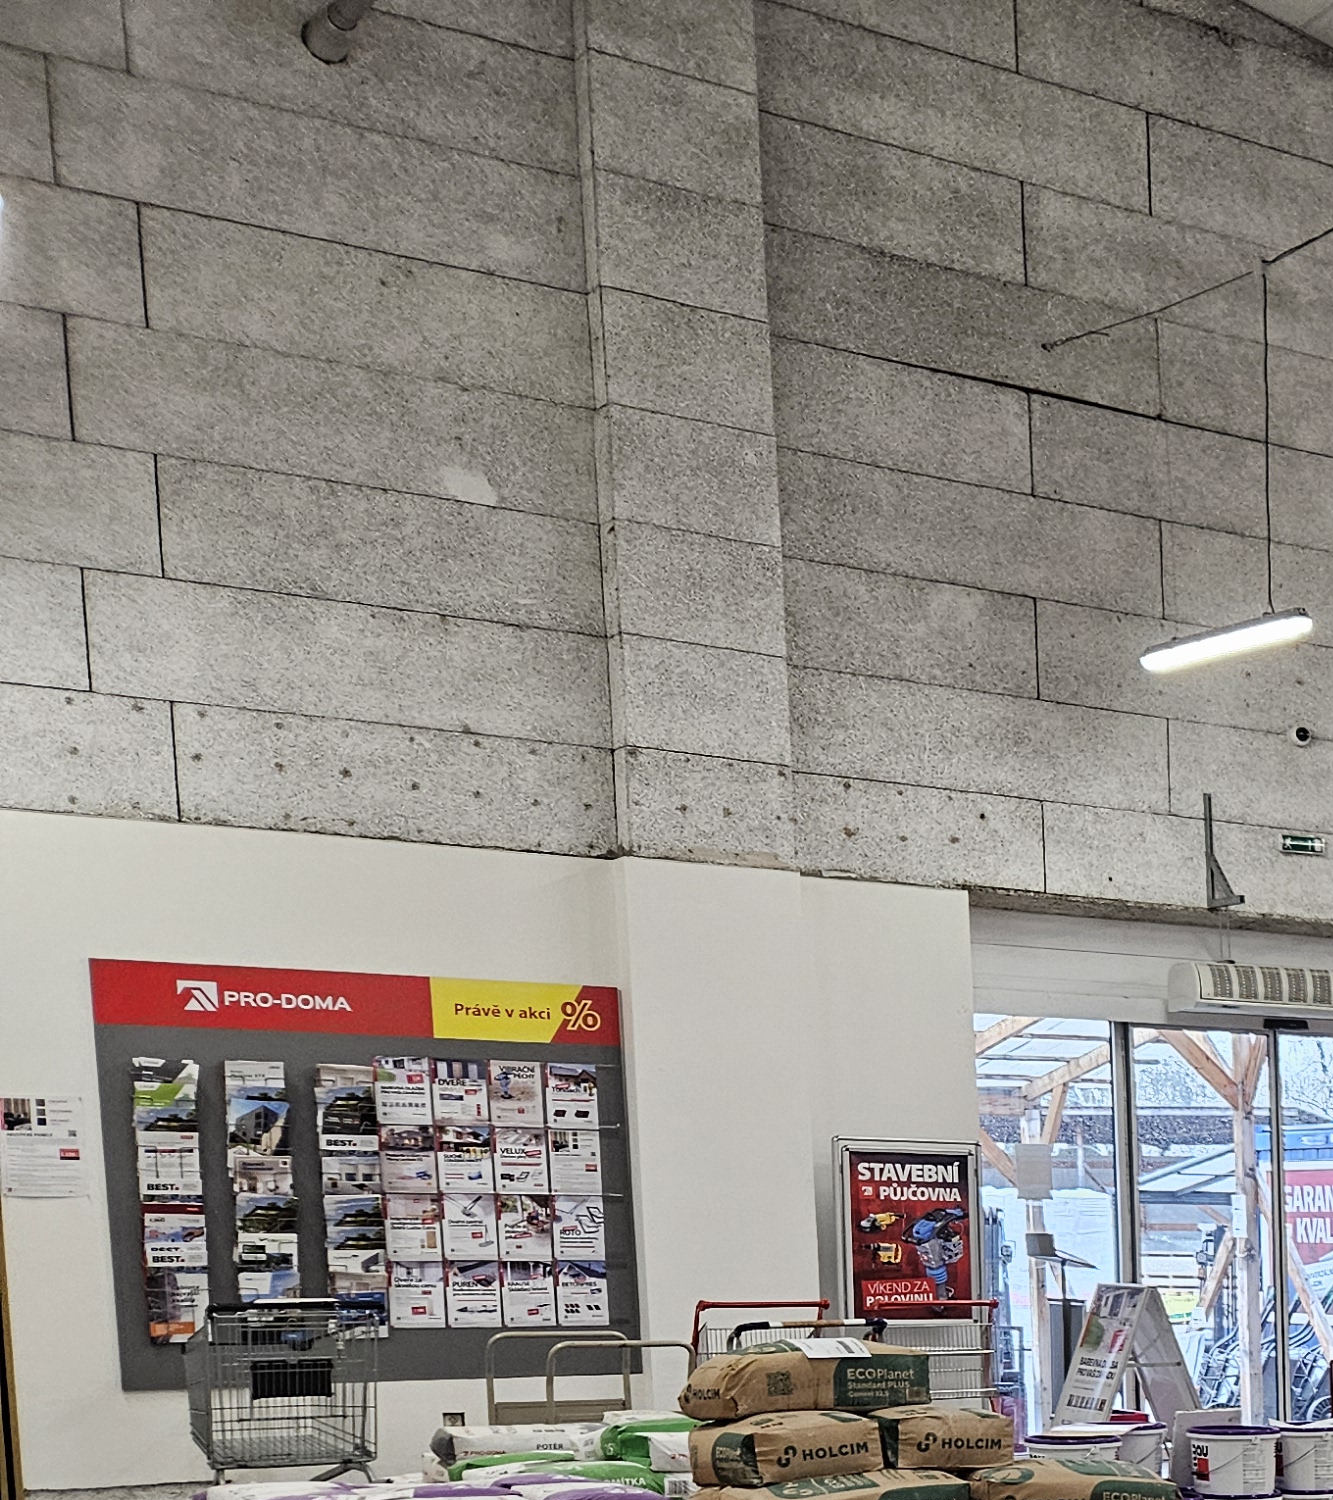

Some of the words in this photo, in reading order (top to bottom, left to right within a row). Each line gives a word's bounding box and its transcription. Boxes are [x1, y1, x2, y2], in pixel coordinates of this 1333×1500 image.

[224, 991, 353, 1012] PRO-DOMA
[454, 1003, 500, 1018] Právě
[505, 1008, 515, 1018] v
[519, 1005, 551, 1020] akci
[500, 1147, 526, 1156] VELUX
[857, 1161, 960, 1183] STAVEBNÍ
[879, 1182, 962, 1202] PŮJČOVNA
[452, 1280, 479, 1288] PUREN
[868, 1281, 911, 1294] VÍKEND
[913, 1280, 930, 1291] ZA
[846, 1368, 915, 1381] ECOPlanet
[847, 1381, 886, 1389] Standard
[888, 1380, 910, 1389] PLUS
[942, 1437, 1002, 1450] HOLCIM
[802, 1441, 869, 1461] HOLCIM
